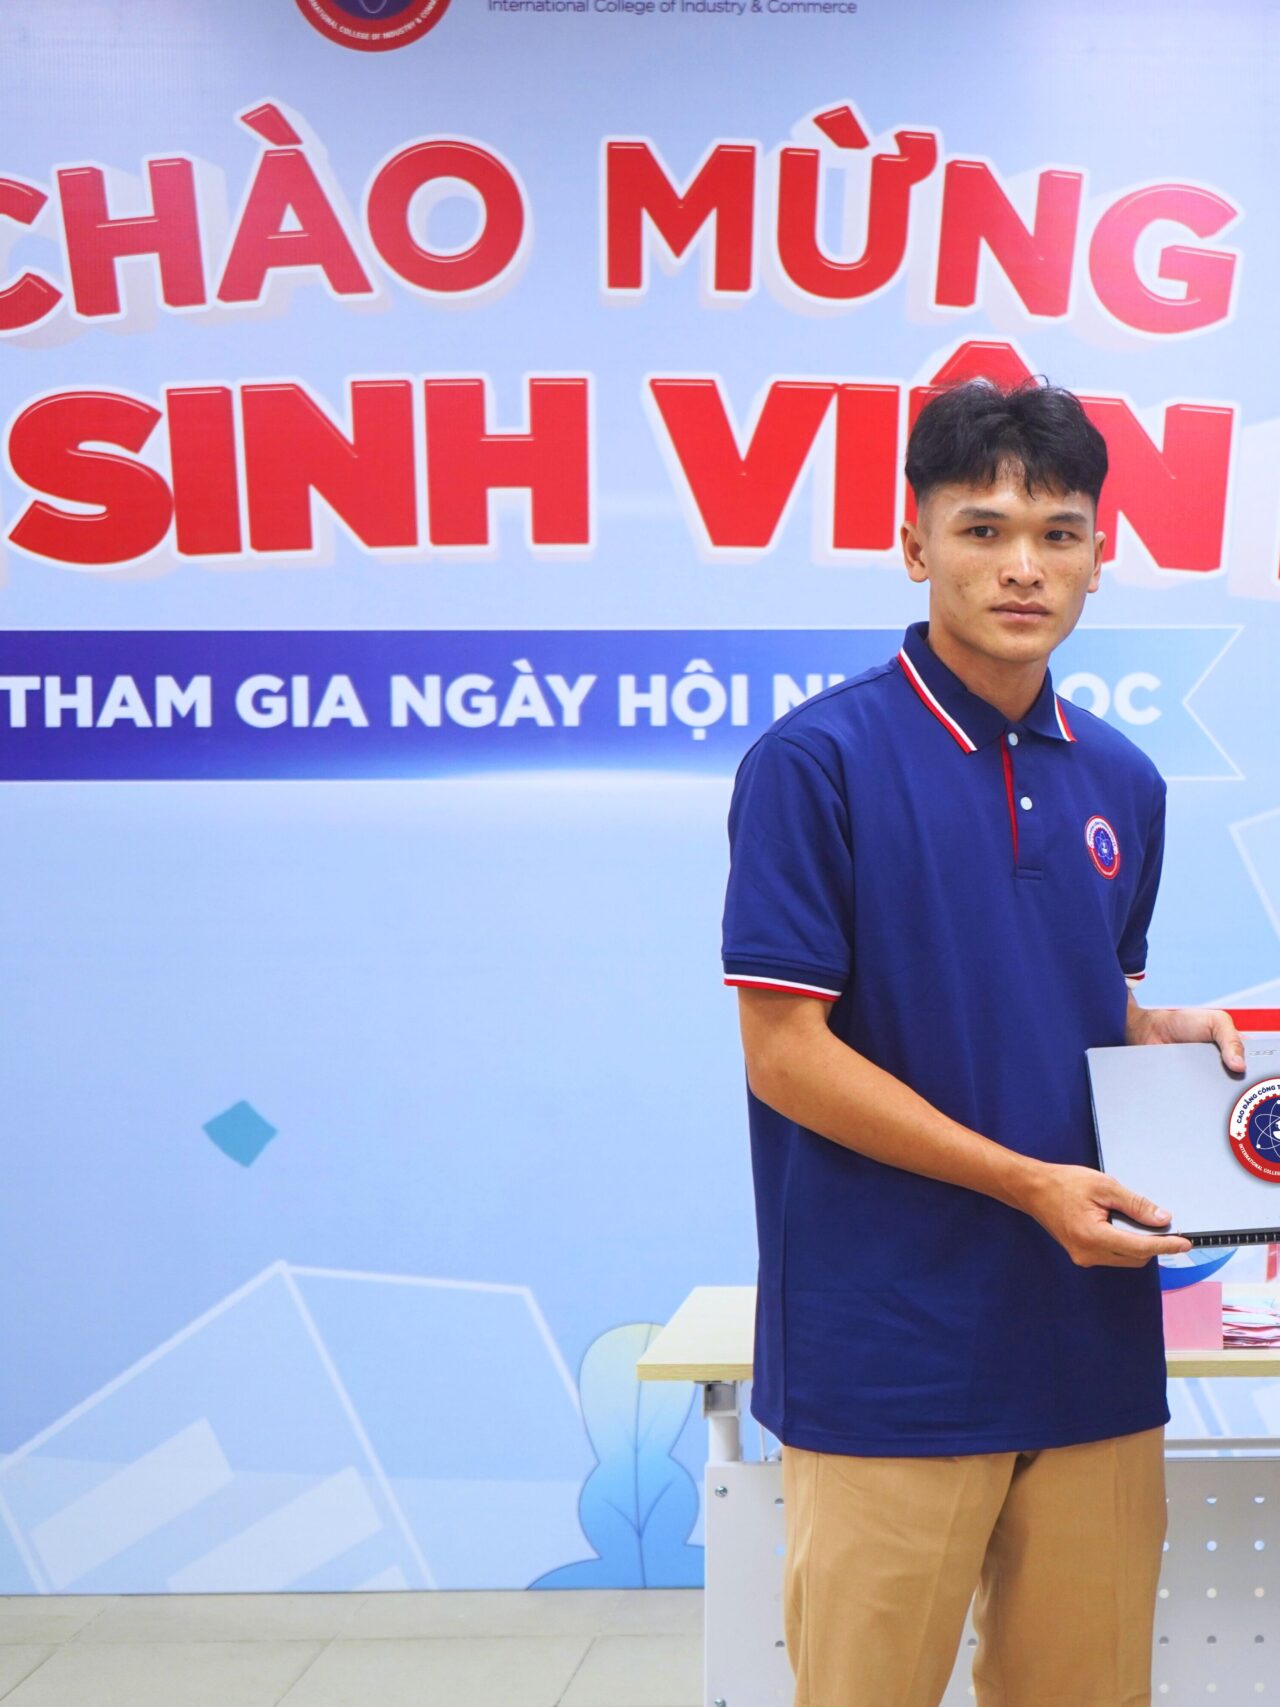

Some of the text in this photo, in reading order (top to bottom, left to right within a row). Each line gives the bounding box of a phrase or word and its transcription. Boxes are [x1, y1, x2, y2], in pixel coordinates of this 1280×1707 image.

[488, 0, 858, 16] International College of Industry & Commerce
[606, 106, 1238, 334] MỪNG
[8, 378, 589, 565] SINH
[650, 341, 1234, 572] VIN
[0, 675, 212, 728] THAM
[235, 674, 368, 728] GIA
[390, 659, 596, 728] NGÀY
[619, 659, 749, 740] HỘI
[1236, 1110, 1245, 1124] CAO
